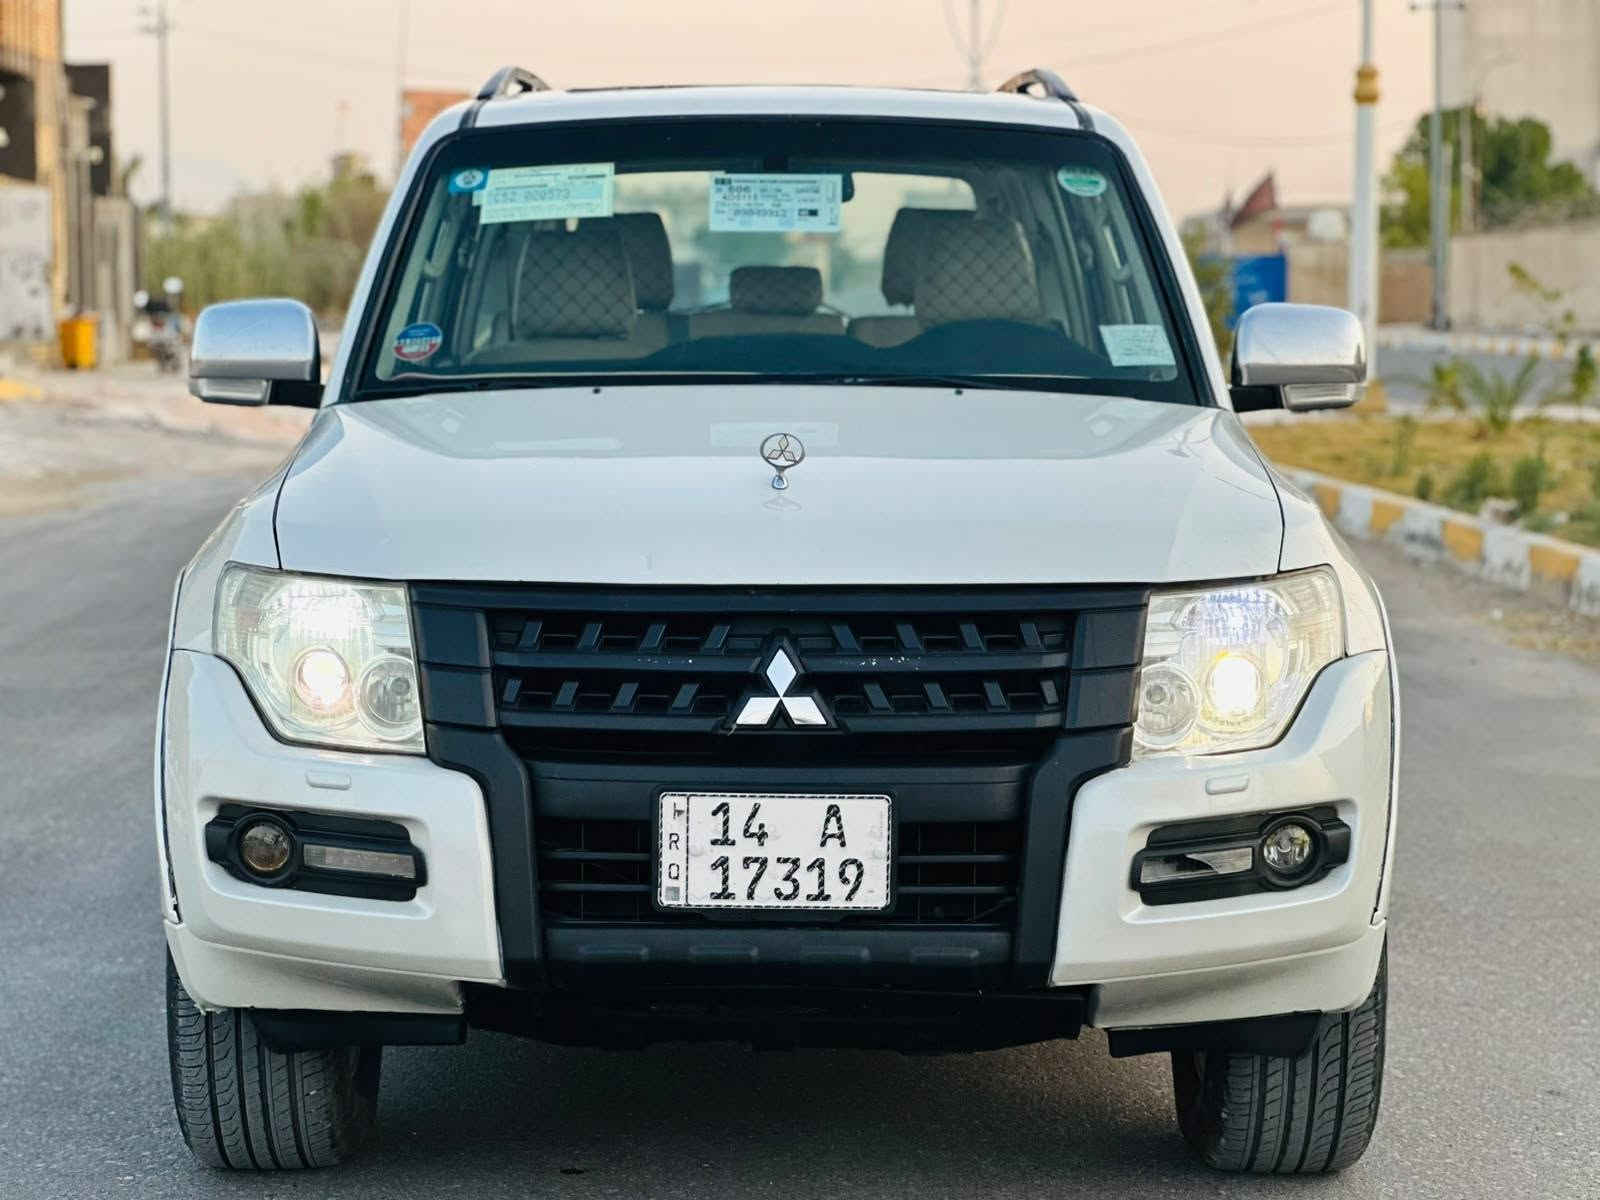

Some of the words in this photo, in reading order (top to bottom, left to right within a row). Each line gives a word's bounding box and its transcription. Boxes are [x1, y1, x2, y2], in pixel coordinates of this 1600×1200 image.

[710, 802, 768, 846] 14
[819, 804, 847, 848] A
[710, 856, 864, 901] 17319
